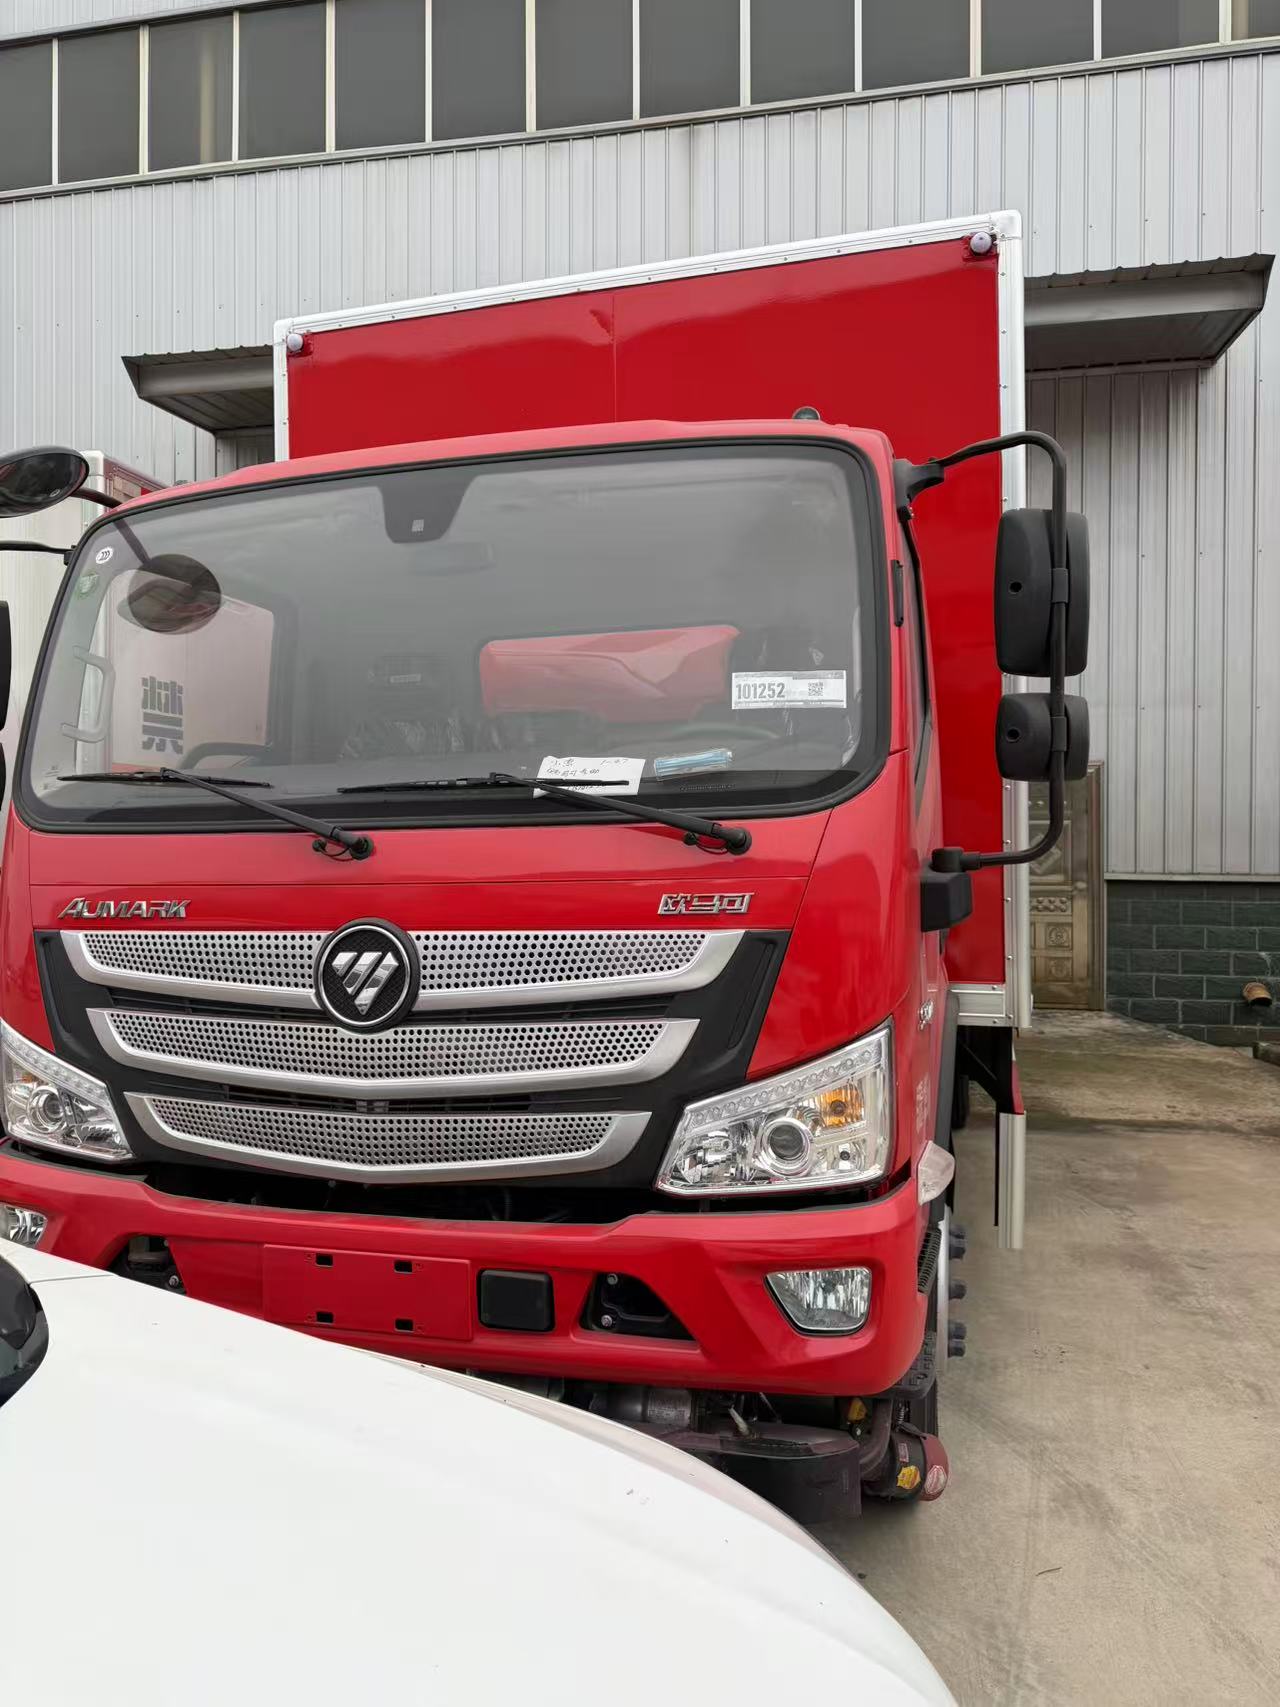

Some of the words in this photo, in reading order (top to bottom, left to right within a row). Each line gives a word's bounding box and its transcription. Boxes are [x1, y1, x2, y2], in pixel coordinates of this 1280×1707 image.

[736, 682, 785, 700] 101252
[57, 897, 191, 918] AUMARK
[658, 893, 755, 915] 欧马可
